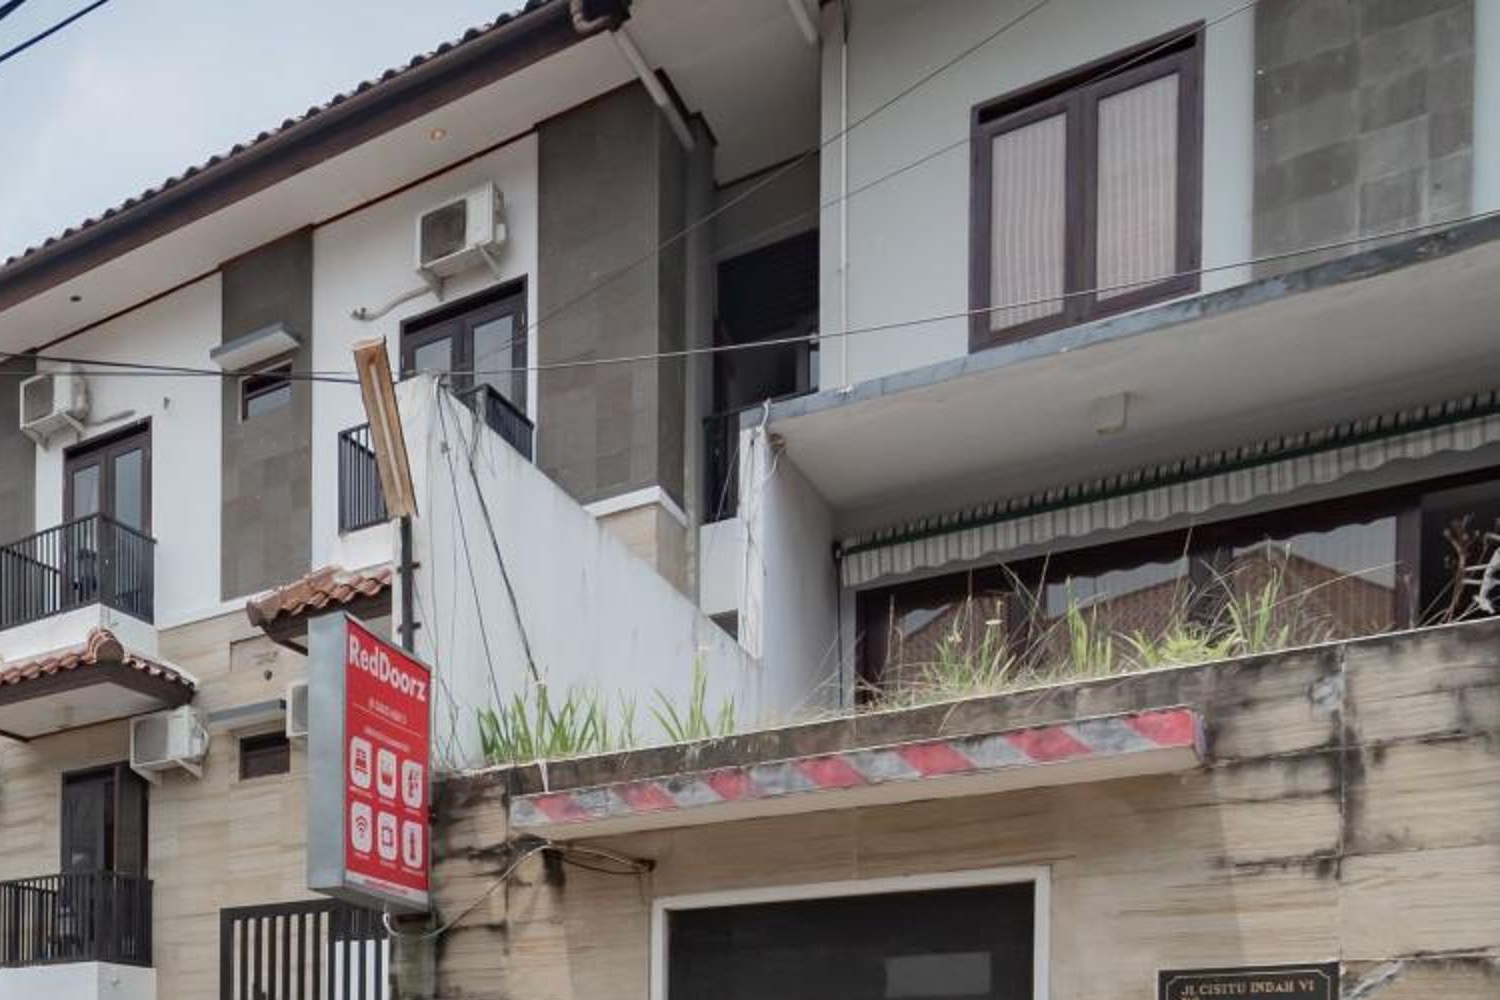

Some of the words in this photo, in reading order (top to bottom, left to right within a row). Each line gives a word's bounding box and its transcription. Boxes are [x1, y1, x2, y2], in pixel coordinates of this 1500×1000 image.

[349, 634, 426, 702] RedDoorz
[1199, 982, 1247, 995] CISITU
[1250, 980, 1295, 993] INDAH
[1299, 979, 1315, 991] VI
